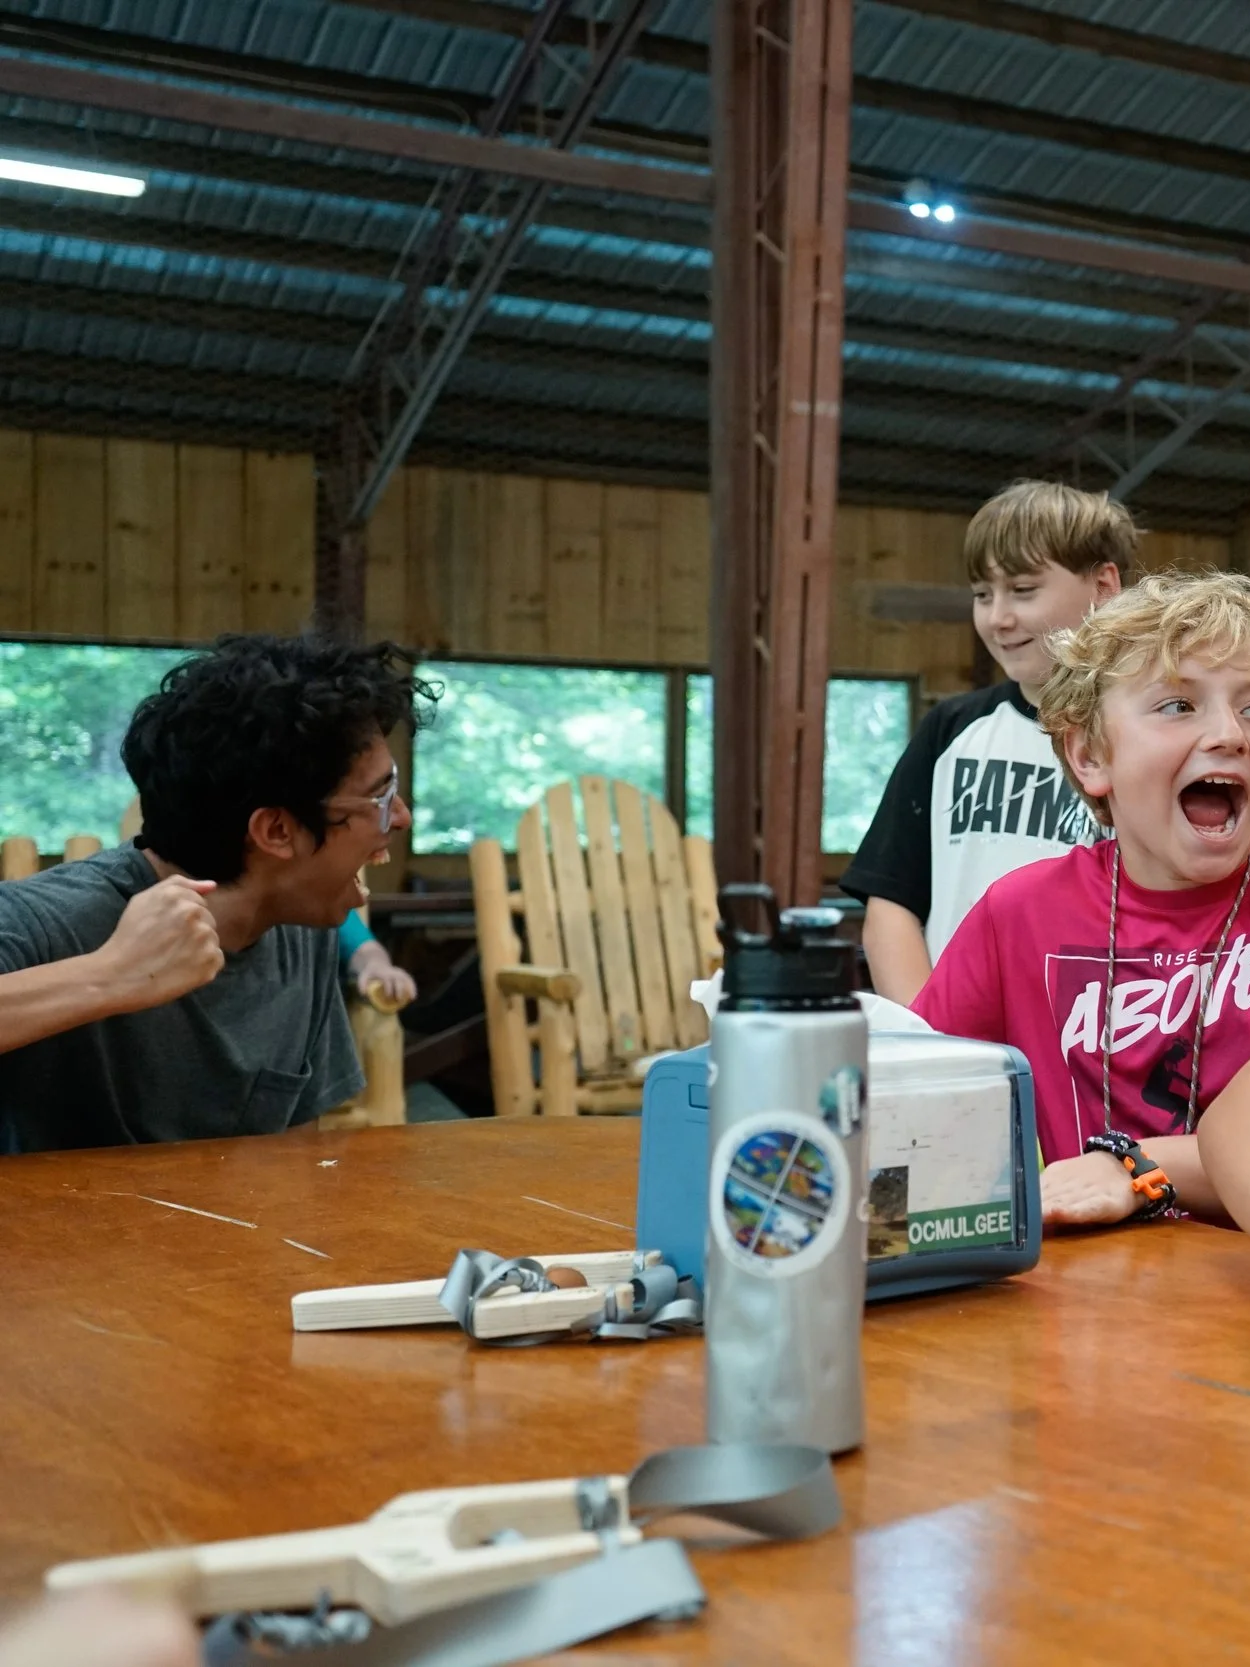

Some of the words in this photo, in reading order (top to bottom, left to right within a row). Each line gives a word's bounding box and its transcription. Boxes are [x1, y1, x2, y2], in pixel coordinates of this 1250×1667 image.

[950, 758, 1082, 845] BATM
[1154, 948, 1198, 967] RISE
[908, 1210, 1012, 1244] OCMULGEE
